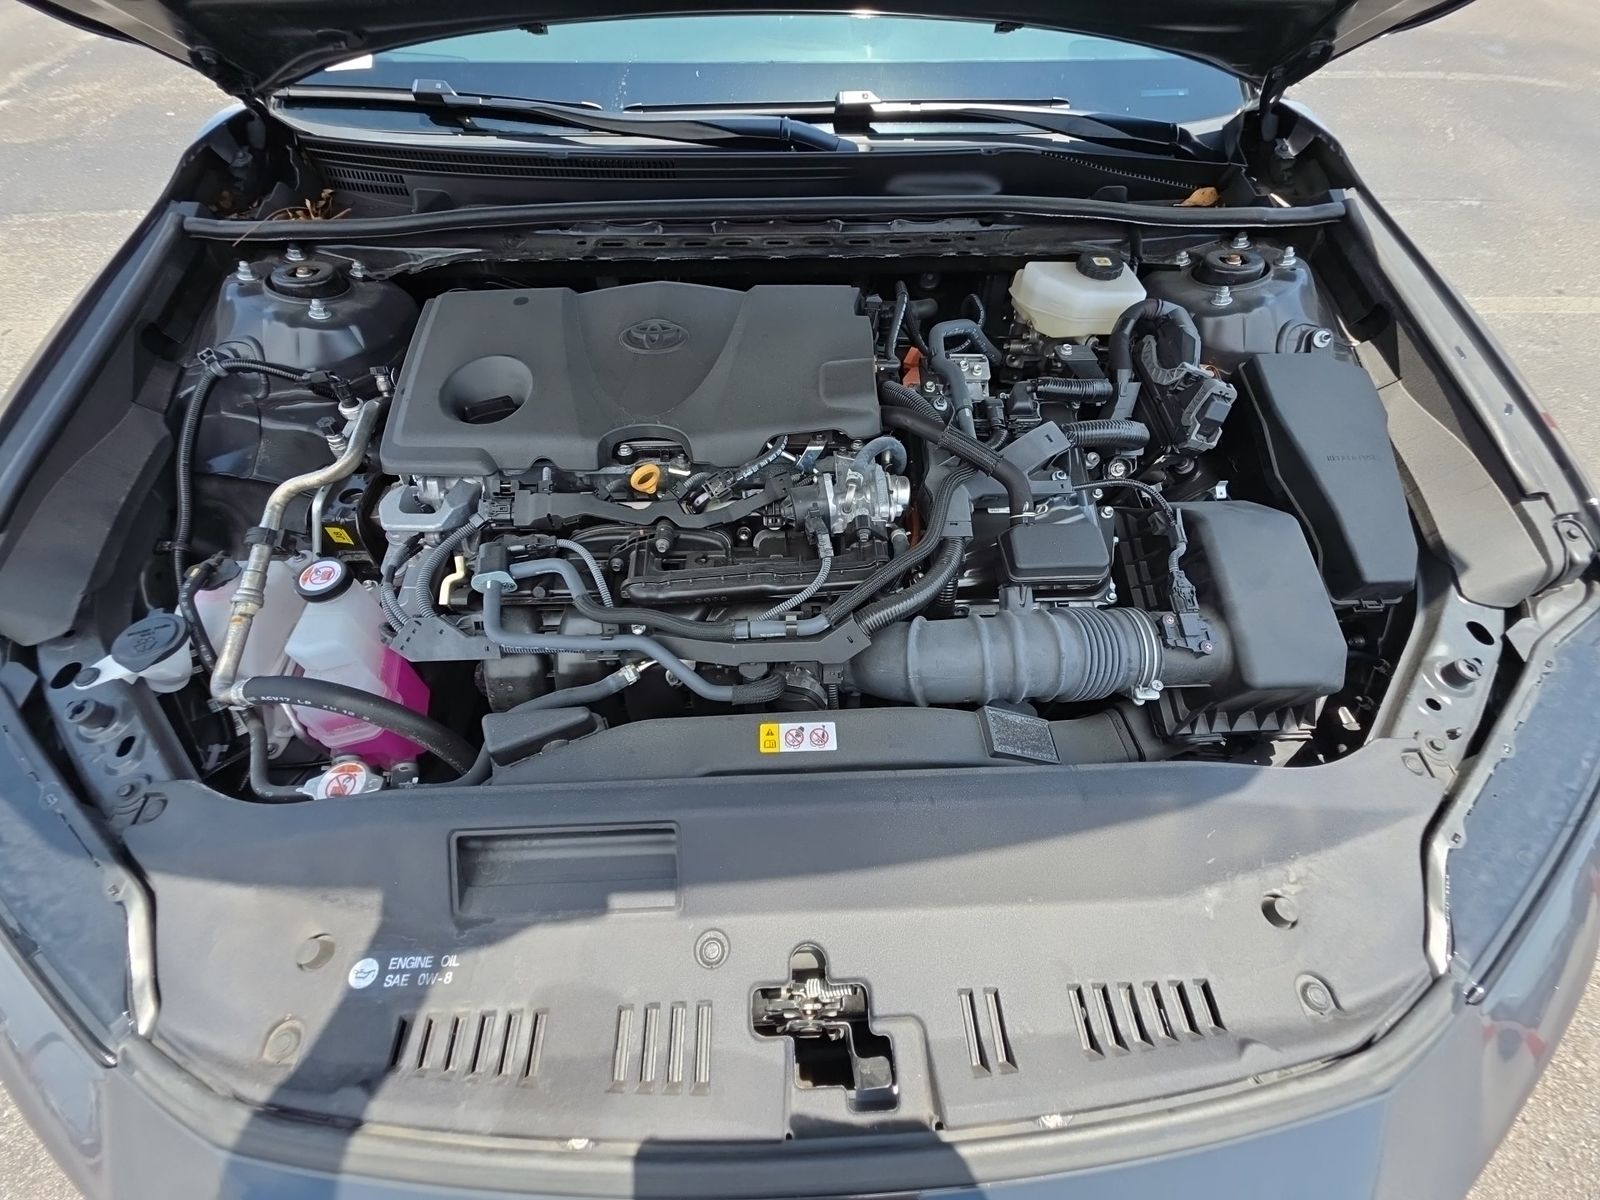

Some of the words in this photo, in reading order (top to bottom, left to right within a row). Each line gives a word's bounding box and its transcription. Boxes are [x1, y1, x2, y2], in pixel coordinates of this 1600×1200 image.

[388, 956, 435, 970] ENGINE
[440, 954, 460, 968] OIL
[383, 973, 411, 988] SAE
[417, 971, 453, 986] 0W-8
